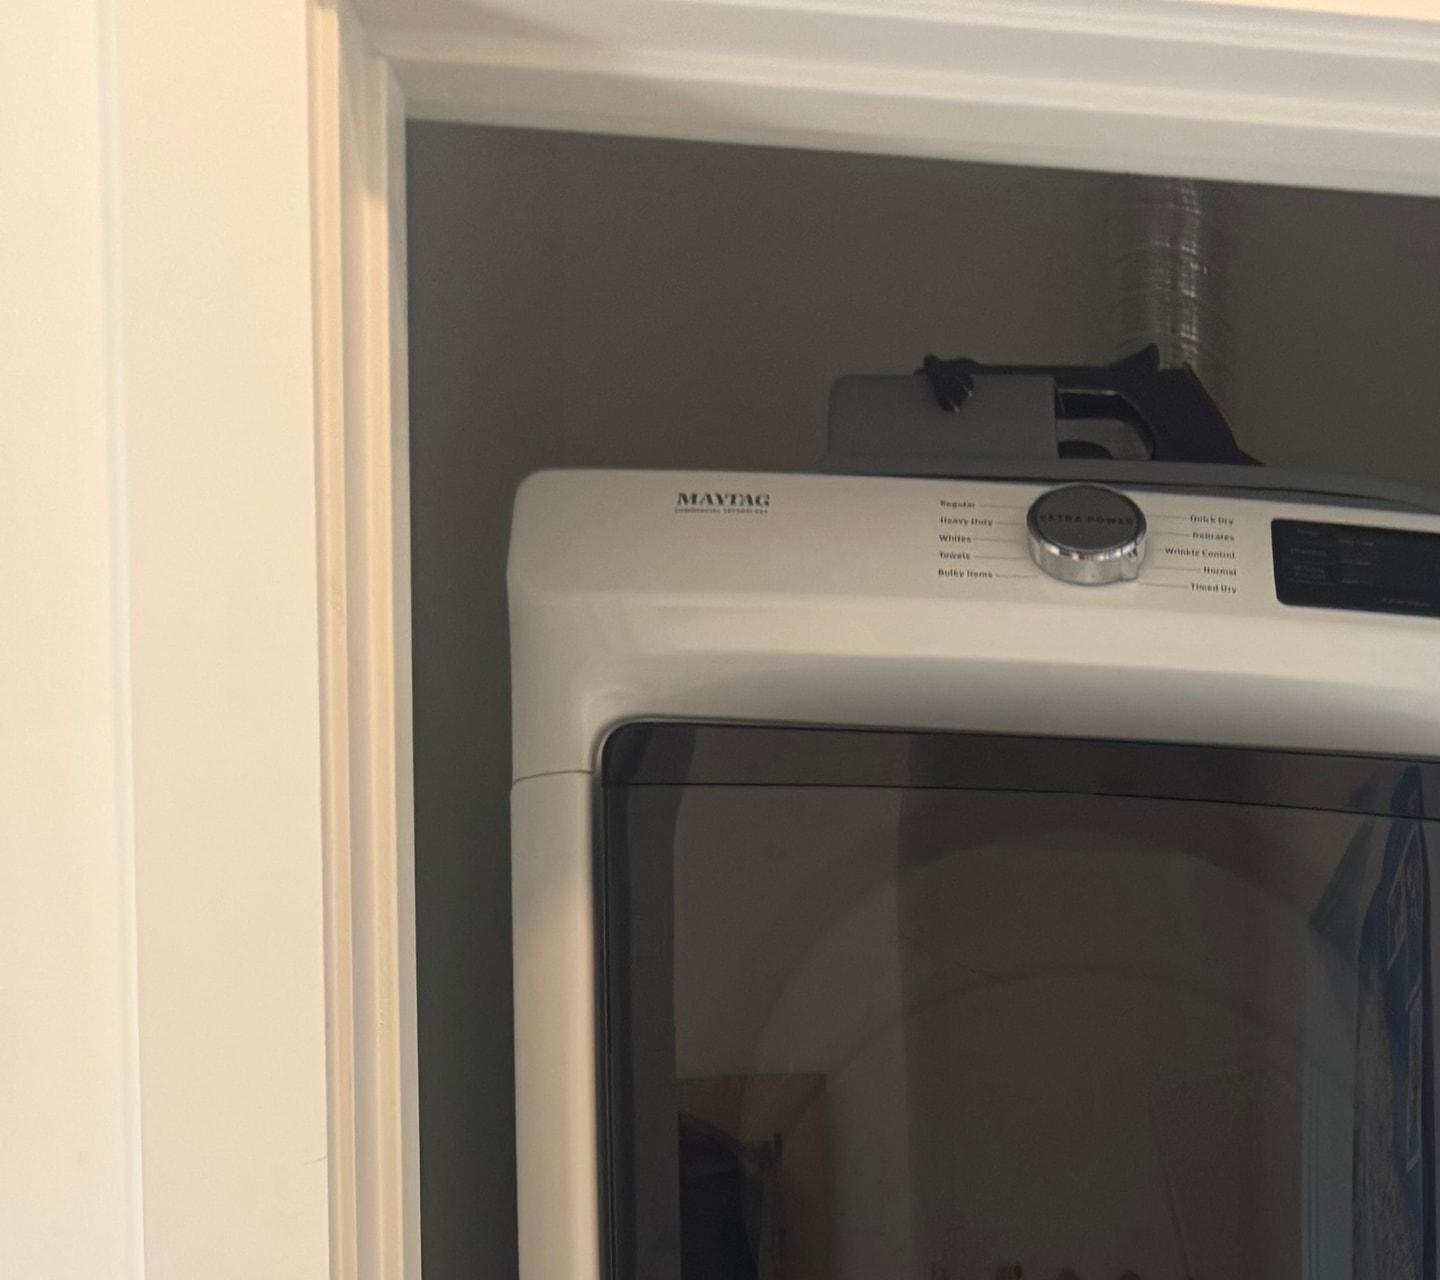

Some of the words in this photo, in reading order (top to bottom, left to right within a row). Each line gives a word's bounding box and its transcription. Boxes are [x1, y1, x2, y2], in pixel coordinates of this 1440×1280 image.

[677, 492, 770, 507] MAYTAG
[940, 500, 975, 509] Regular
[940, 516, 969, 525] Heavy
[971, 517, 993, 526] Duty
[1040, 513, 1082, 522] EXTRA
[1087, 515, 1133, 525] POWER
[1218, 516, 1233, 526] Dry
[939, 534, 971, 543] Whites
[1192, 531, 1235, 541] Delicates
[940, 551, 970, 560] Towels
[1165, 547, 1200, 556] Wrinkle
[1202, 549, 1235, 559] Control
[938, 568, 964, 578] Bulky
[967, 570, 993, 579] Items
[1203, 566, 1236, 576] Normal
[1221, 584, 1237, 594] Dry
